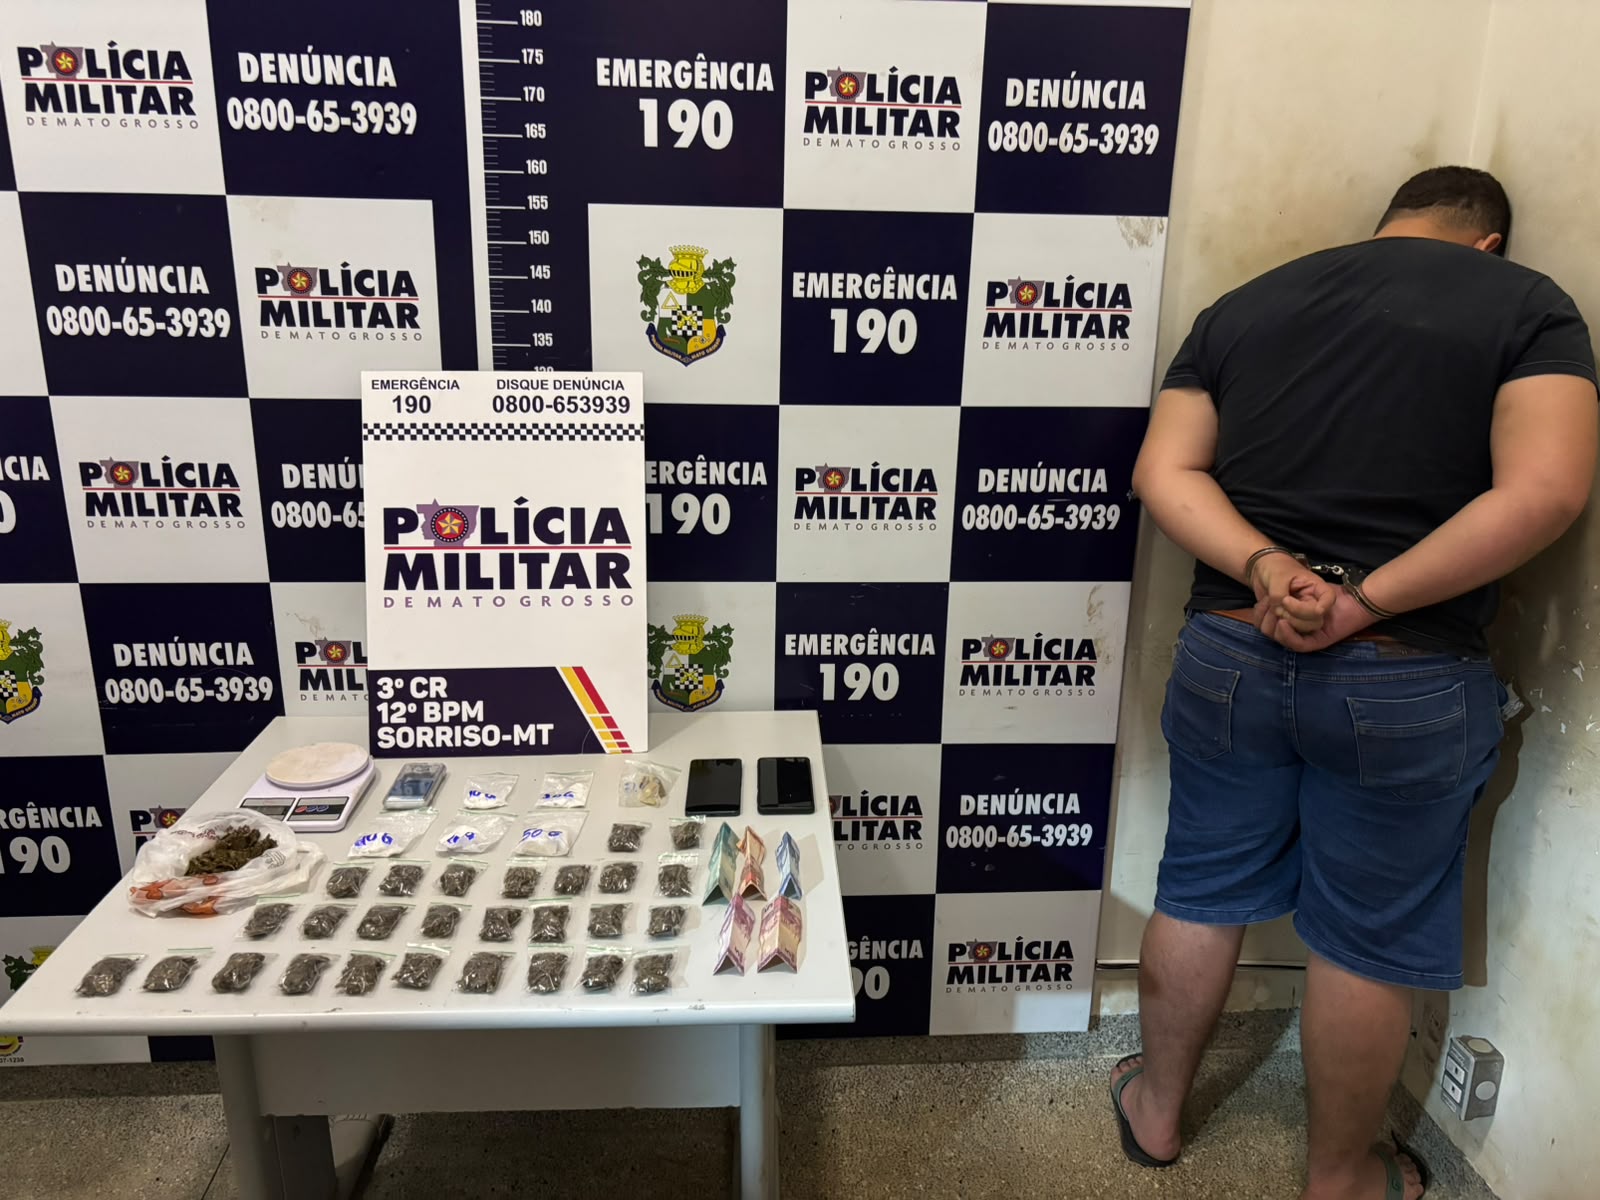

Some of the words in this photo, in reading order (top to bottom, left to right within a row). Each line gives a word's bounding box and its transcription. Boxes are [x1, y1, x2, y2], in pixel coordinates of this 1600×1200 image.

[519, 10, 542, 26] 180
[17, 40, 193, 81] POLÍCIA
[238, 45, 397, 88] DENÚNCIA
[521, 48, 544, 65] 175
[596, 53, 774, 91] EMERGÊNCIA
[523, 86, 545, 102] 170
[805, 66, 961, 105] POLÍCIA
[1006, 71, 1146, 110] DENÚNCIA
[24, 83, 197, 116] MILITAR
[26, 117, 49, 128] DE
[56, 117, 111, 129] MATO
[119, 118, 200, 130] GROSSO
[226, 97, 418, 135] 0800-65-3939
[639, 98, 733, 150] 190
[803, 106, 960, 138] MILITAR
[525, 123, 546, 139] 165
[803, 137, 822, 147] DE
[830, 138, 880, 149] MATO
[888, 139, 961, 151] GROSSO
[987, 121, 1160, 155] 0800-65-3939
[526, 159, 547, 175] 160
[527, 195, 548, 210] 155
[528, 230, 549, 245] 150
[55, 257, 209, 294] DENÚNCIA
[254, 261, 419, 297] POLÍCIA
[530, 264, 551, 279] 145
[792, 266, 957, 299] EMERGÊNCIA
[986, 274, 1132, 309] POLÍCIA
[259, 300, 421, 329] MILITAR
[531, 299, 552, 313] 140
[46, 305, 231, 338] 0800-65-3939
[830, 308, 918, 355] 190
[983, 313, 1130, 339] MILITAR
[261, 330, 281, 340] DE
[289, 331, 341, 341] MATO
[349, 331, 422, 341] GROSSO
[532, 333, 553, 347] 135
[982, 341, 1000, 350] DE
[1007, 341, 1054, 350] MATO
[1062, 341, 1131, 351] GROSSO
[371, 377, 460, 390] EMERGÊNCIA
[496, 379, 549, 391] DISQUE
[553, 377, 625, 391] DENÚNCIA
[392, 395, 431, 413] 190
[492, 395, 630, 414] 0800-653939
[78, 455, 239, 488] POLÍCIA
[281, 457, 365, 489] DENÚ
[645, 455, 767, 485] ERGÊNCIA
[795, 461, 937, 493] POLÍCIA
[978, 461, 1107, 493] DENÚNCIA
[85, 493, 243, 517] MILITAR
[645, 493, 731, 535] 190
[794, 496, 937, 520] MILITAR
[962, 504, 1120, 530] 0800-65-3939
[87, 520, 107, 528] DE
[114, 520, 164, 528] MATO
[173, 520, 246, 529] GROSSO
[383, 496, 631, 545] POLÍCIA
[818, 523, 863, 531] MATO
[871, 523, 937, 531] GROSSO
[383, 553, 632, 590] MILITAR
[384, 597, 413, 608] DE
[427, 596, 505, 608] MATO
[519, 595, 633, 607] GROSSO
[113, 636, 254, 667] DENÚNCIA
[785, 628, 936, 655] EMERGÊNCIA
[962, 632, 1097, 661] POLÍCIA
[409, 677, 447, 698] CR
[820, 663, 899, 701] 190
[960, 665, 1095, 686] MILITAR
[105, 676, 273, 703] 0800-65-3939
[983, 689, 1025, 697] MATO
[1033, 689, 1096, 697] GROSSO
[423, 701, 484, 722] BPM
[377, 724, 554, 749] SORRISO-MT
[0, 801, 103, 829] RGÊNCIA
[829, 790, 923, 817] LÍCIA
[960, 788, 1080, 816] DENÚNCIA
[834, 820, 922, 842] LITAR
[946, 823, 1093, 848] 0800-65-3939
[848, 936, 924, 960] GÊNCIA
[948, 936, 1074, 962] POLÍCIA
[946, 963, 1073, 985] MILITAR
